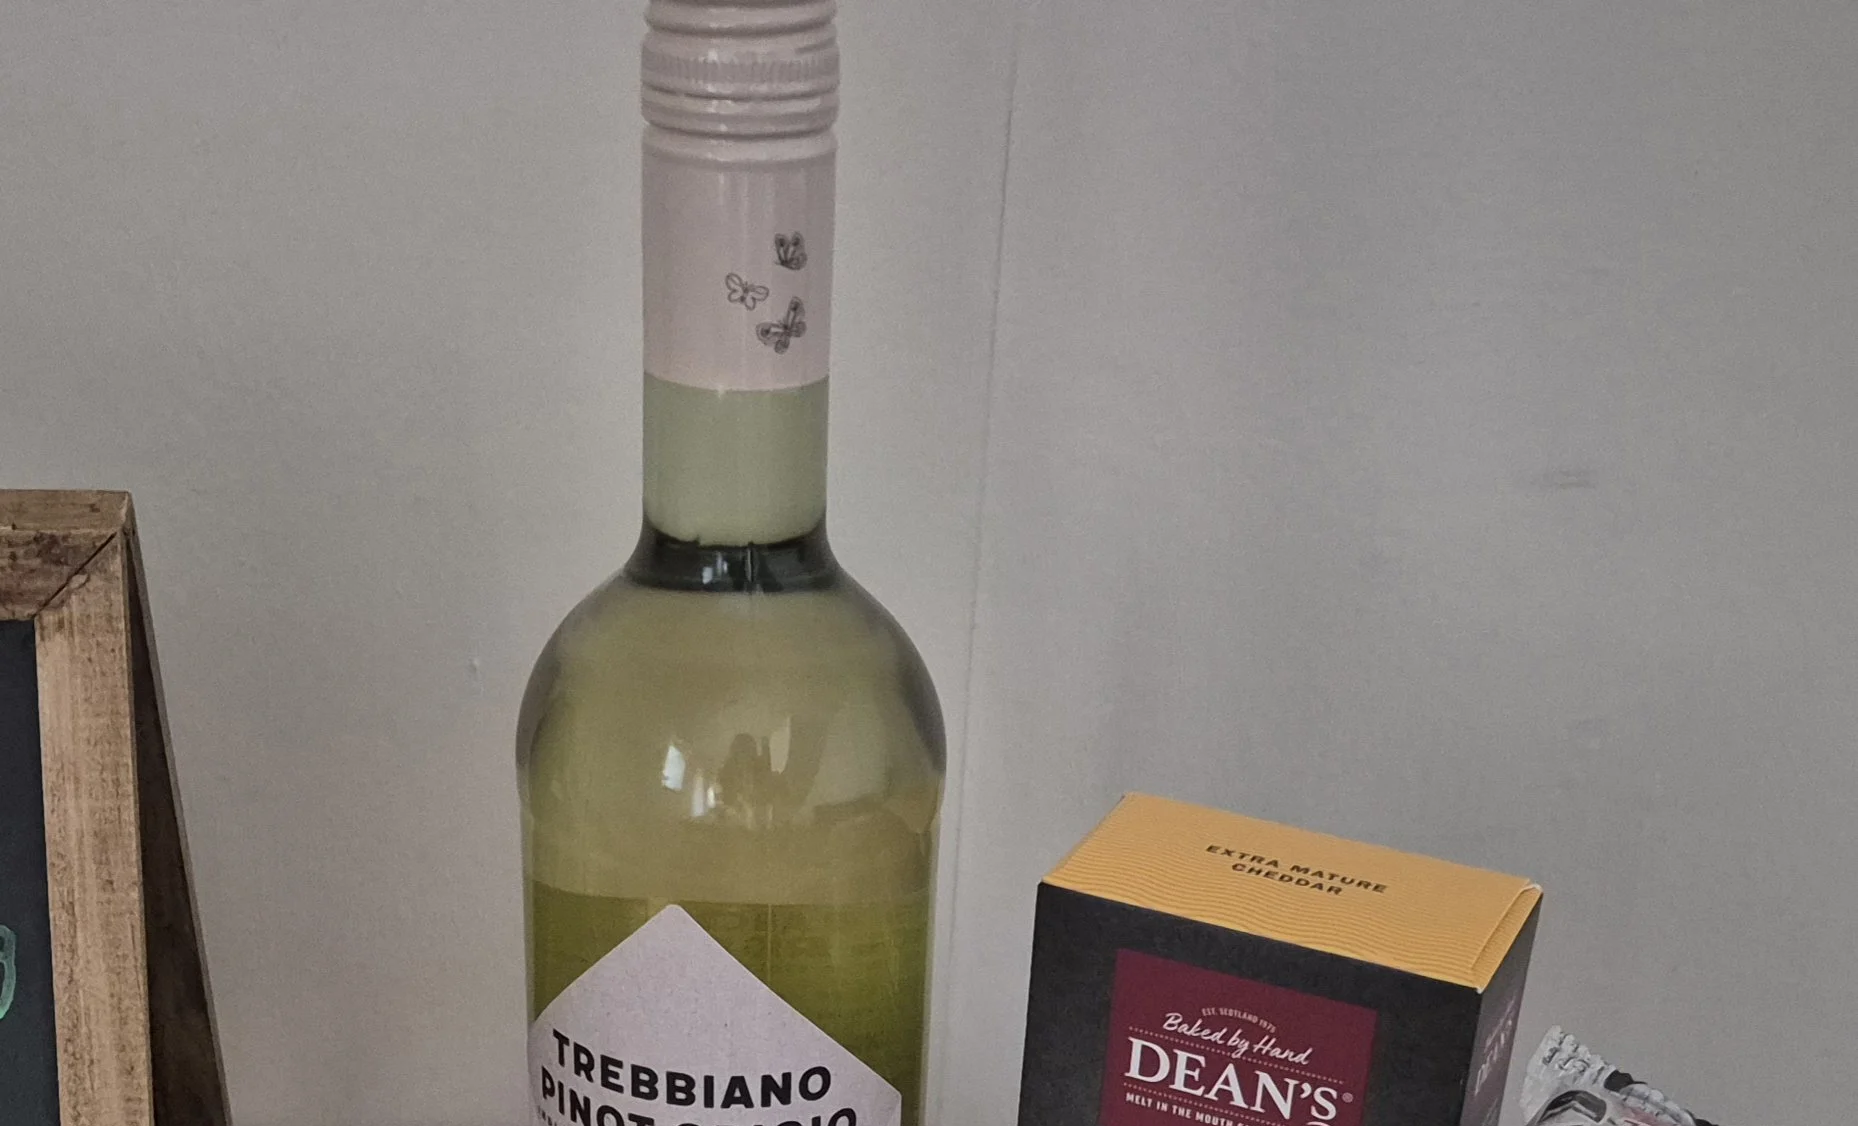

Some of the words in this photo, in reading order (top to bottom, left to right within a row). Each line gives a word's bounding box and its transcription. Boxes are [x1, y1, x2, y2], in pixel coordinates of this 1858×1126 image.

[1206, 844, 1280, 869] EXTRA
[1289, 864, 1388, 893] MATURE
[1231, 862, 1343, 895] CHEDDAR
[1162, 1012, 1228, 1044] Baked
[1227, 1028, 1250, 1059] by
[1252, 1035, 1313, 1065] Hand
[1219, 1007, 1259, 1024] SCOTLAND
[552, 1028, 832, 1110] TREBBIANO
[1123, 1037, 1338, 1124] DEAN'S
[1125, 1092, 1153, 1109] MELT
[1156, 1100, 1168, 1113] IN
[1170, 1104, 1192, 1119] THE
